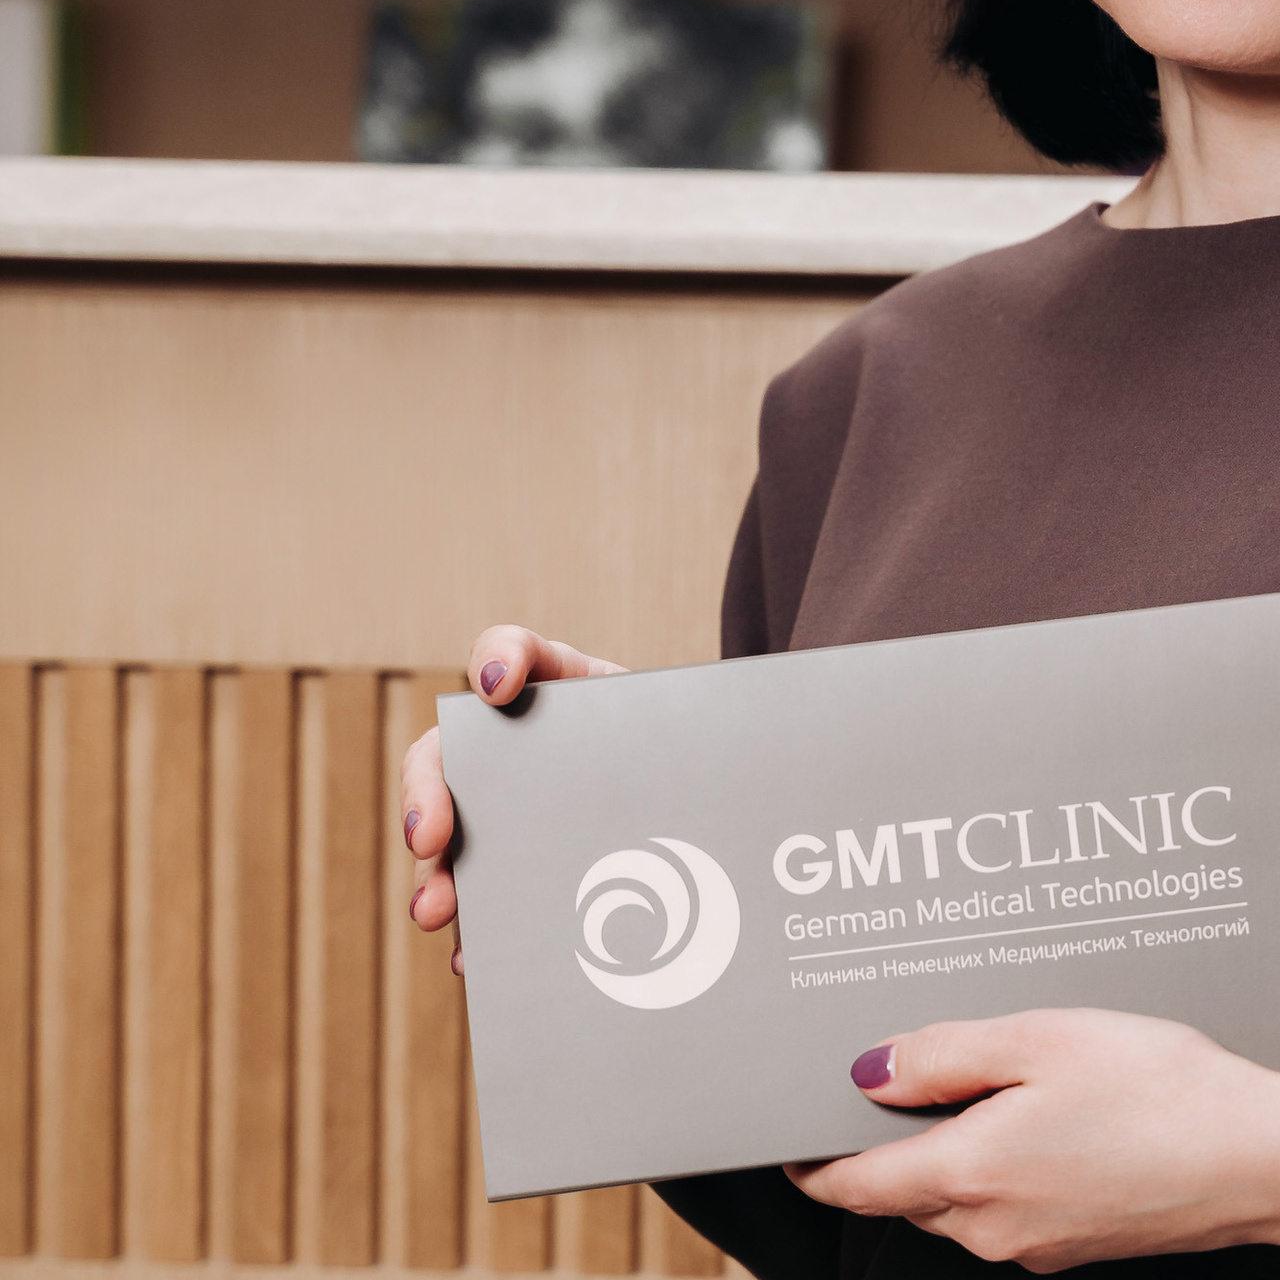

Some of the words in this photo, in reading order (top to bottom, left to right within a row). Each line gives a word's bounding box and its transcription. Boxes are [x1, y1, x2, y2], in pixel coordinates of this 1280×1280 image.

[784, 905, 907, 941] German
[916, 885, 1035, 926] Medical
[1041, 863, 1244, 911] Technologies
[790, 963, 878, 989] Клиника
[882, 950, 984, 978] Немецких
[988, 932, 1128, 964] Медицинских
[1130, 917, 1250, 949] Технологий
